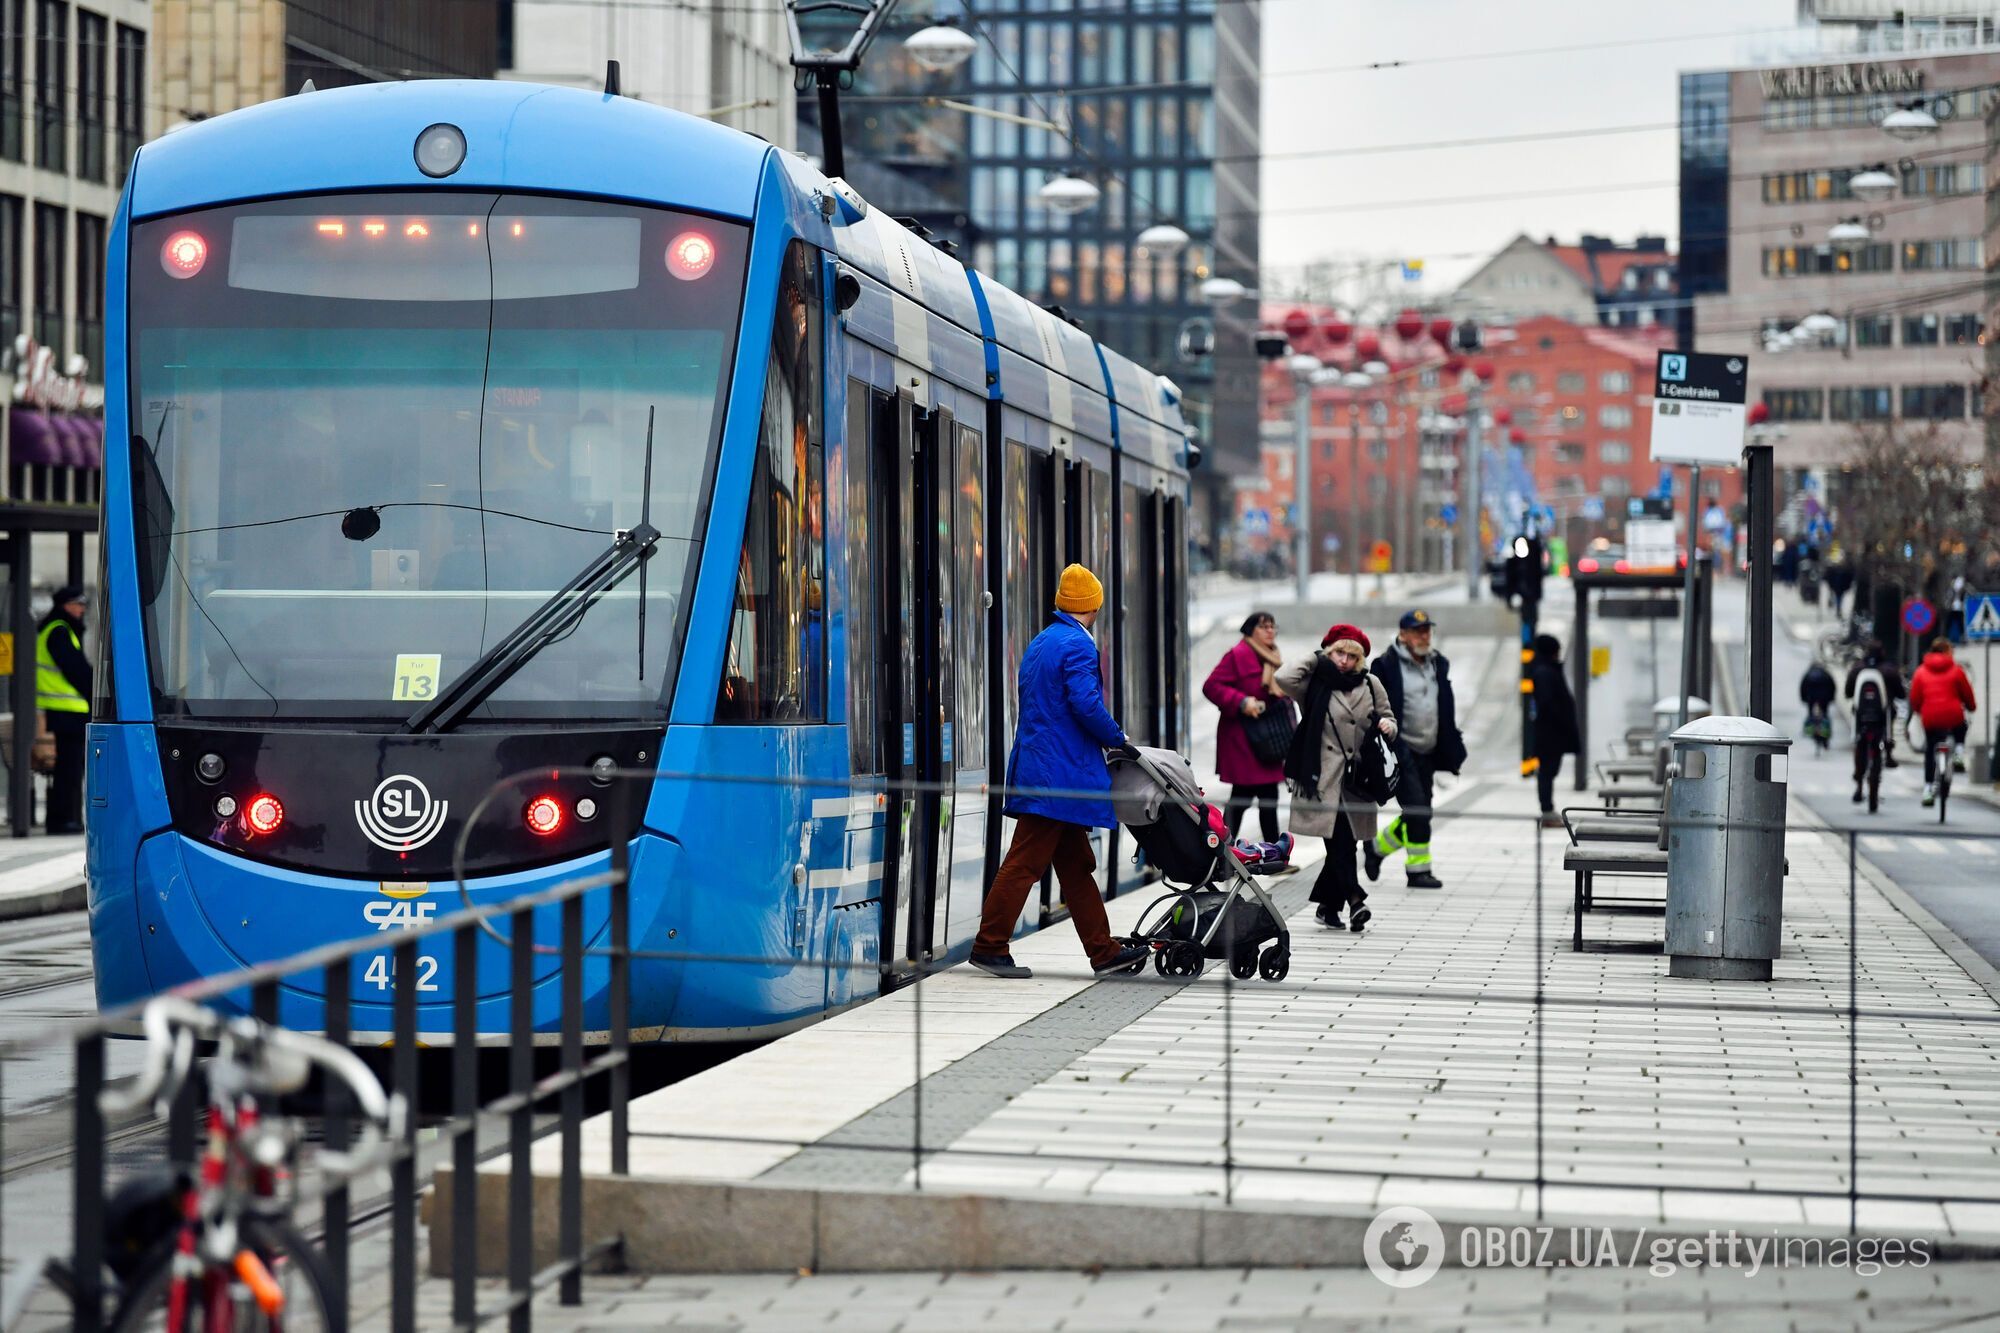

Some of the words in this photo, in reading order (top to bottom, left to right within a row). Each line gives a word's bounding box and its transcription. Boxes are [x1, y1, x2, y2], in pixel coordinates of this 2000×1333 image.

[1660, 383, 1719, 400] T-Centralen
[399, 675, 432, 698] 13
[382, 788, 421, 818] SL
[363, 901, 437, 930] CAF
[364, 955, 438, 991] 42
